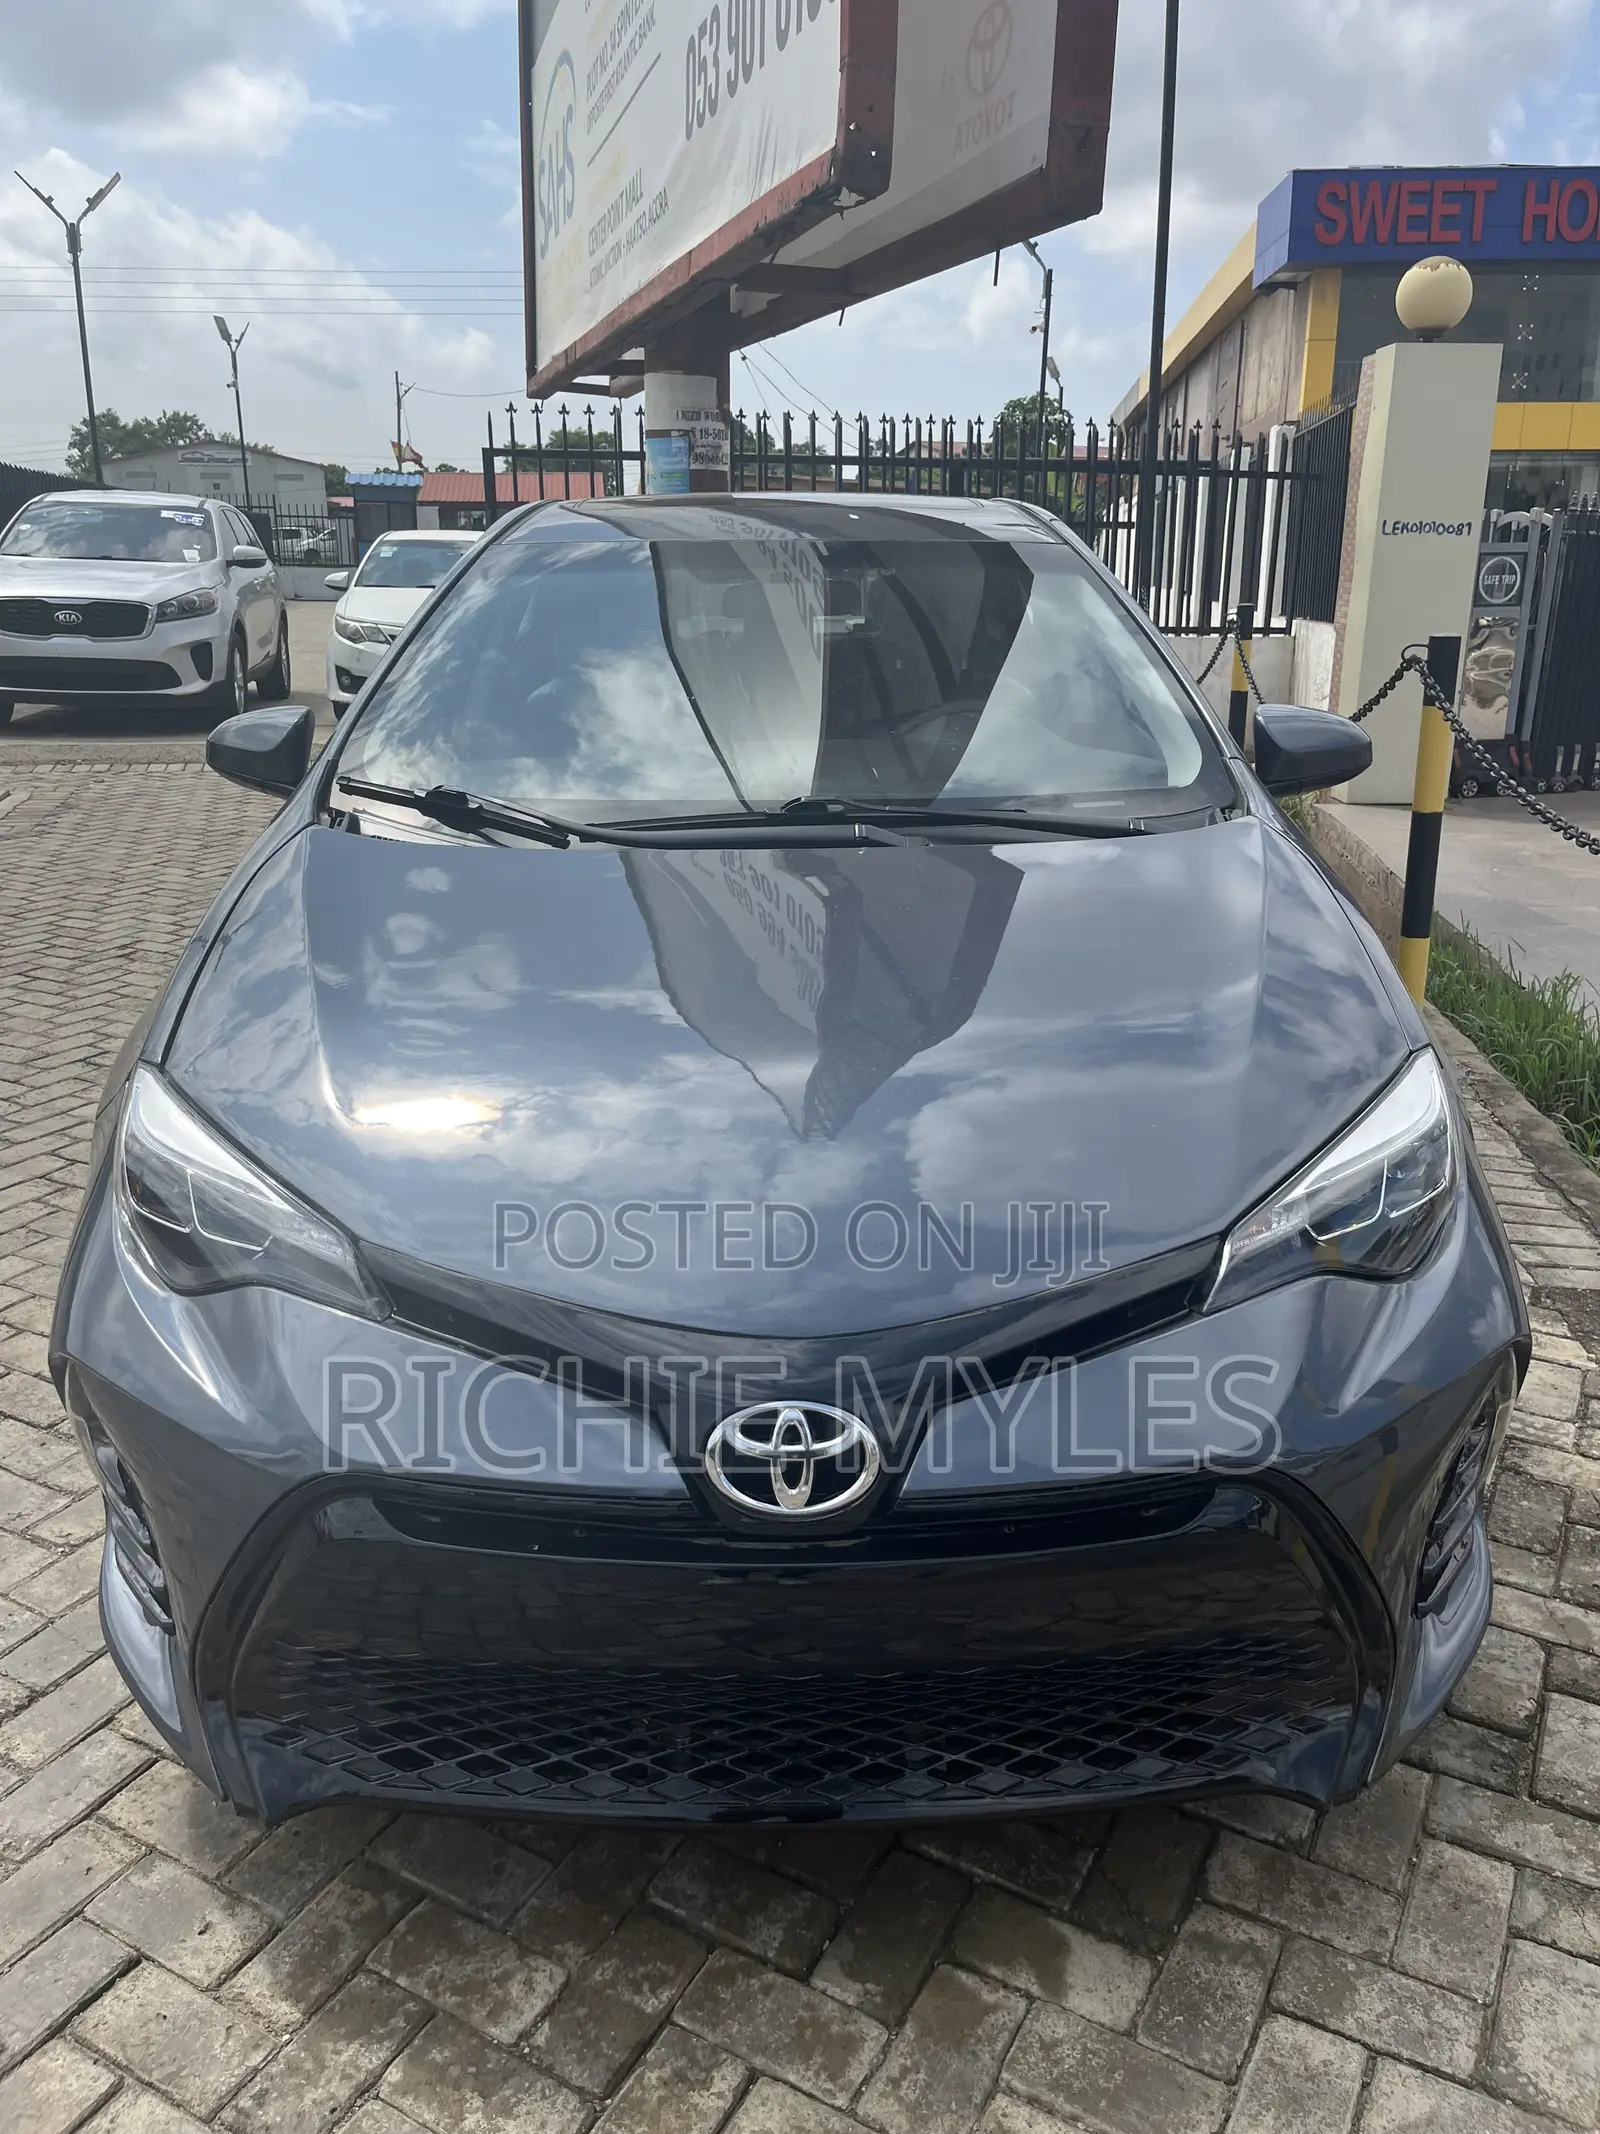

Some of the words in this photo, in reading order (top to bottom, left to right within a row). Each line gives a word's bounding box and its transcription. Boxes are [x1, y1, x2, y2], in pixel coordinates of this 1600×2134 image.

[685, 4, 721, 141] 053
[727, 0, 766, 98] 901
[538, 103, 576, 260] SAHS
[625, 166, 643, 219] MALL
[1314, 179, 1497, 246] SWEET
[1521, 178, 1600, 243] HO
[1484, 575, 1500, 585] SAFE
[1502, 575, 1516, 585] TRIP
[58, 613, 78, 622] KIA
